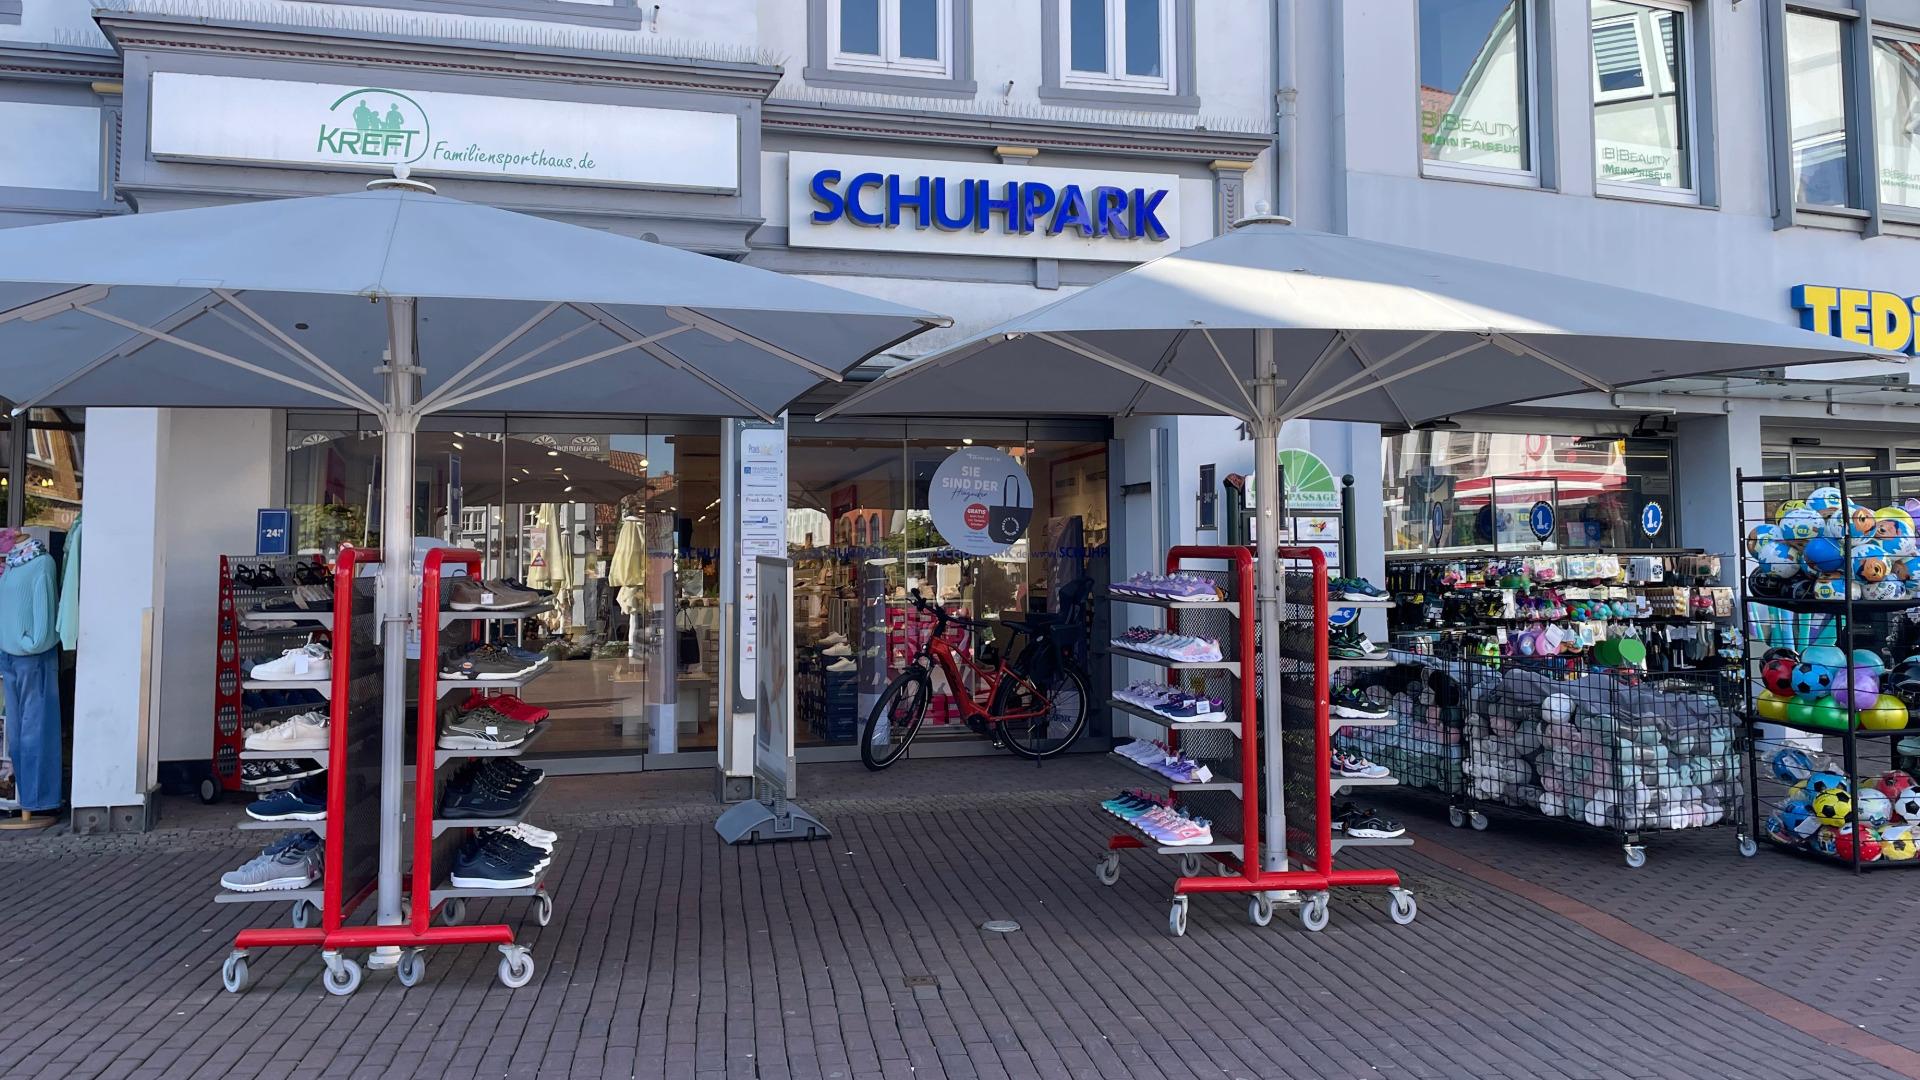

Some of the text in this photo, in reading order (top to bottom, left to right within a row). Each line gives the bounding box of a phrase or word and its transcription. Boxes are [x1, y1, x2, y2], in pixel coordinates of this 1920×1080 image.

[317, 124, 596, 171] KREFT Familiensporthaus.de
[809, 169, 1170, 242] SCHUHPARK
[961, 466, 981, 477] SIE
[942, 477, 999, 491] SIND DER
[1289, 493, 1338, 501] PASSAGE
